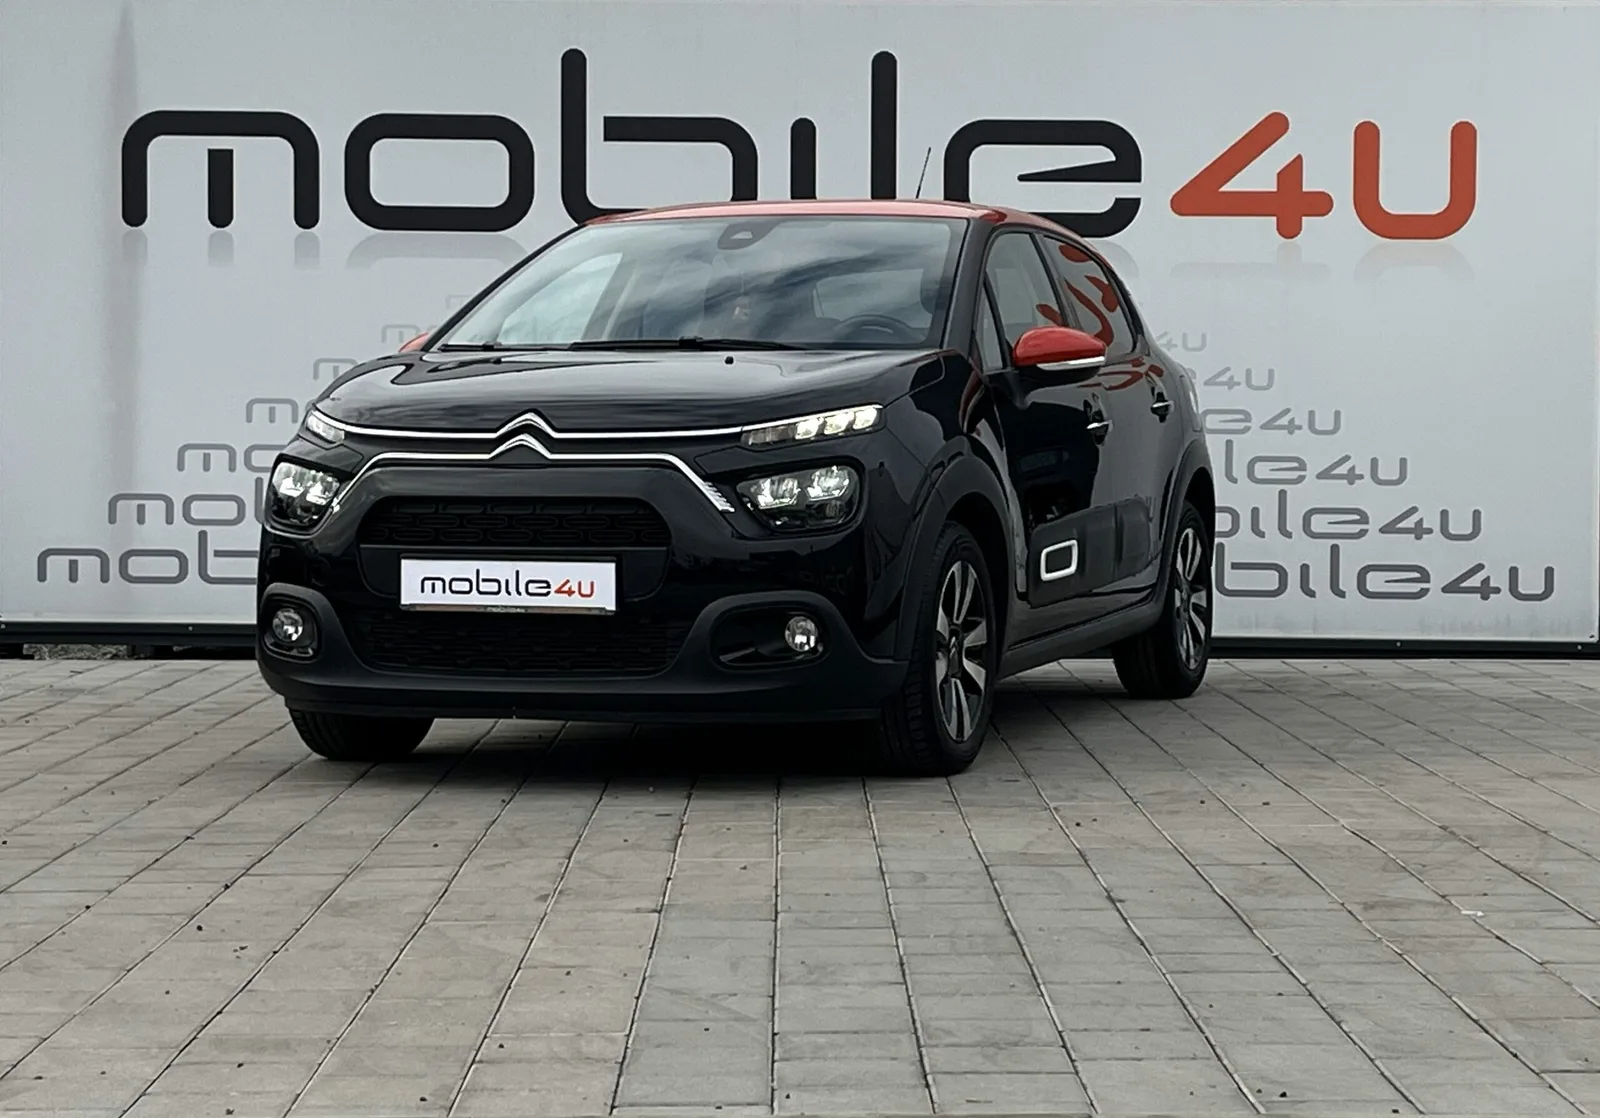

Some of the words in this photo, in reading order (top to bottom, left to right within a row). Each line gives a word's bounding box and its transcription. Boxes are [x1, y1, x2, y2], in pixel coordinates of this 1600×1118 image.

[1224, 439, 1408, 486] le4u
[1215, 489, 1482, 541] ile4u
[1215, 542, 1555, 602] bile4u
